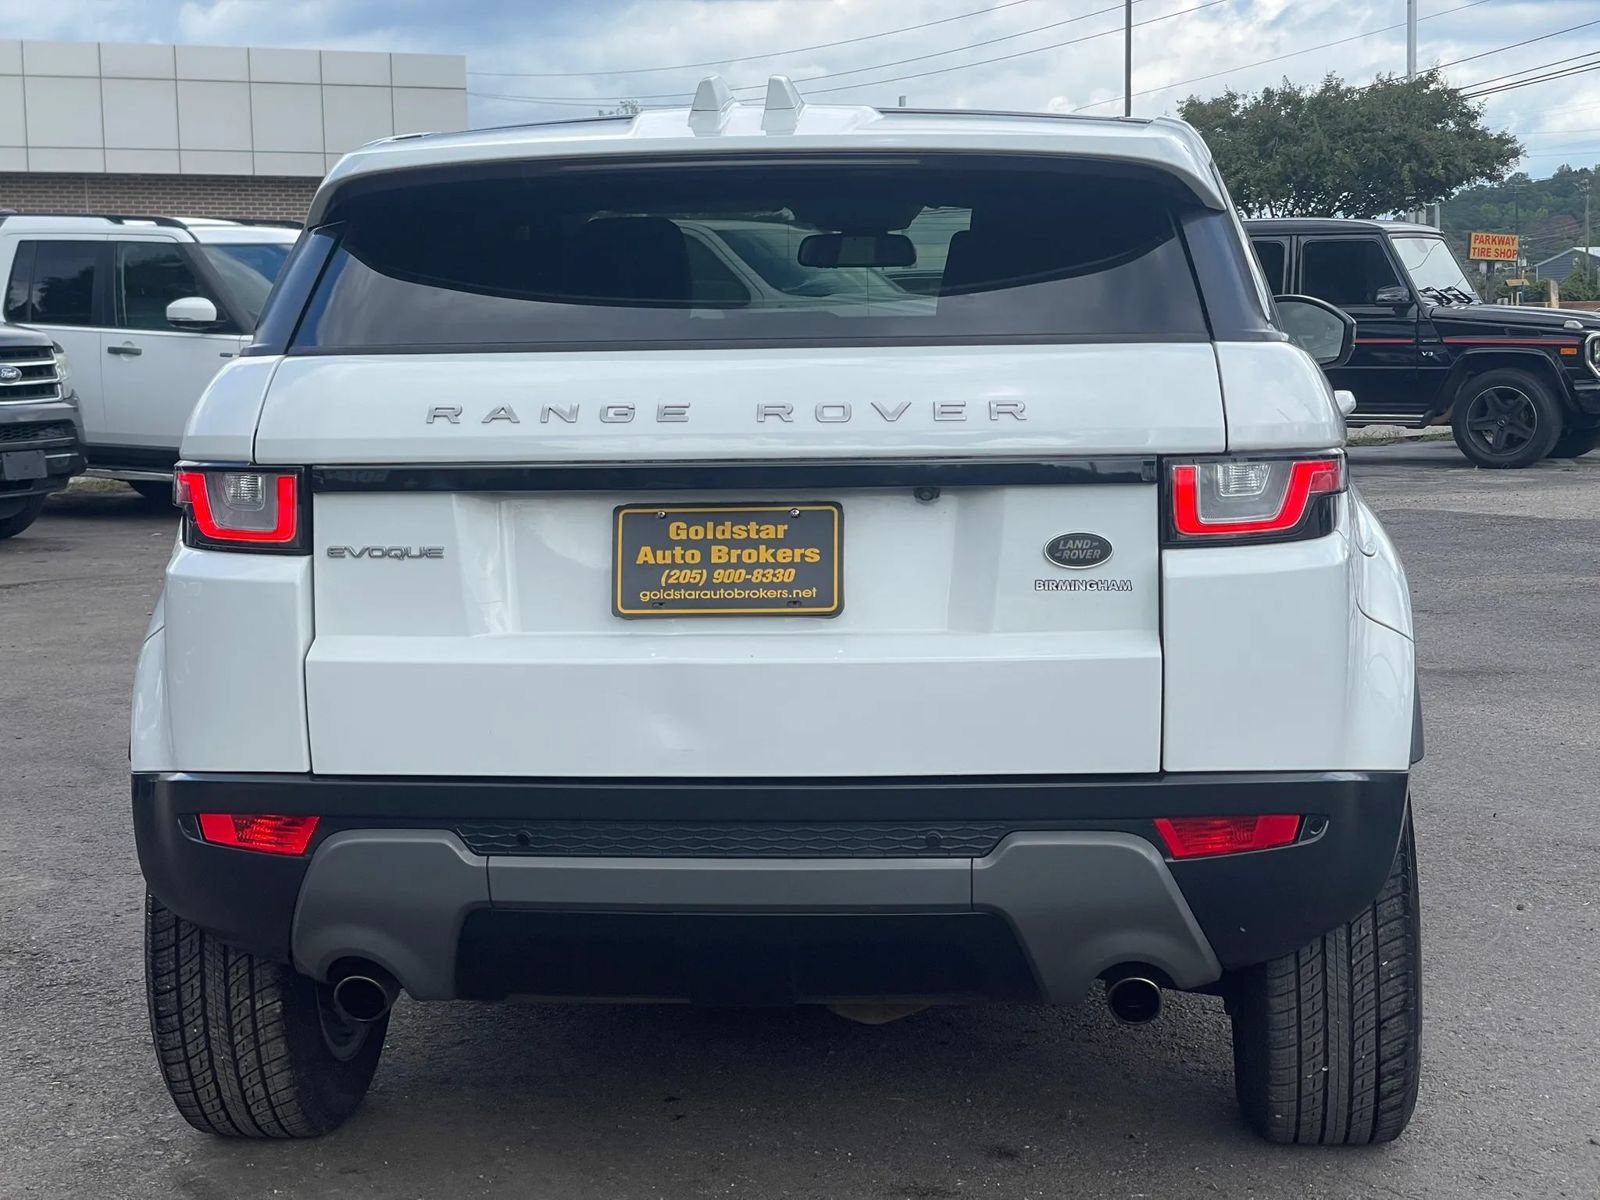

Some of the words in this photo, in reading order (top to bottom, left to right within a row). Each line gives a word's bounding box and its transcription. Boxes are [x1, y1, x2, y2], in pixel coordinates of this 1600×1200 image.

[1473, 234, 1516, 246] PARKWAY
[1472, 247, 1491, 257] TIRE
[1494, 248, 1518, 259] SHOP
[425, 401, 691, 424] RANGE
[756, 399, 1028, 423] ROVER
[668, 521, 789, 541] Goldstar
[1058, 539, 1092, 550] LAND
[326, 545, 445, 561] EVOQUE
[635, 545, 702, 565] Auto
[710, 544, 821, 564] Brokers
[1061, 549, 1102, 560] ROVER
[660, 569, 708, 586] (205)
[712, 568, 797, 584] 900-8330
[1035, 579, 1133, 591] BIRMINGHAM
[639, 587, 817, 602] goldstarautobrokers.net
